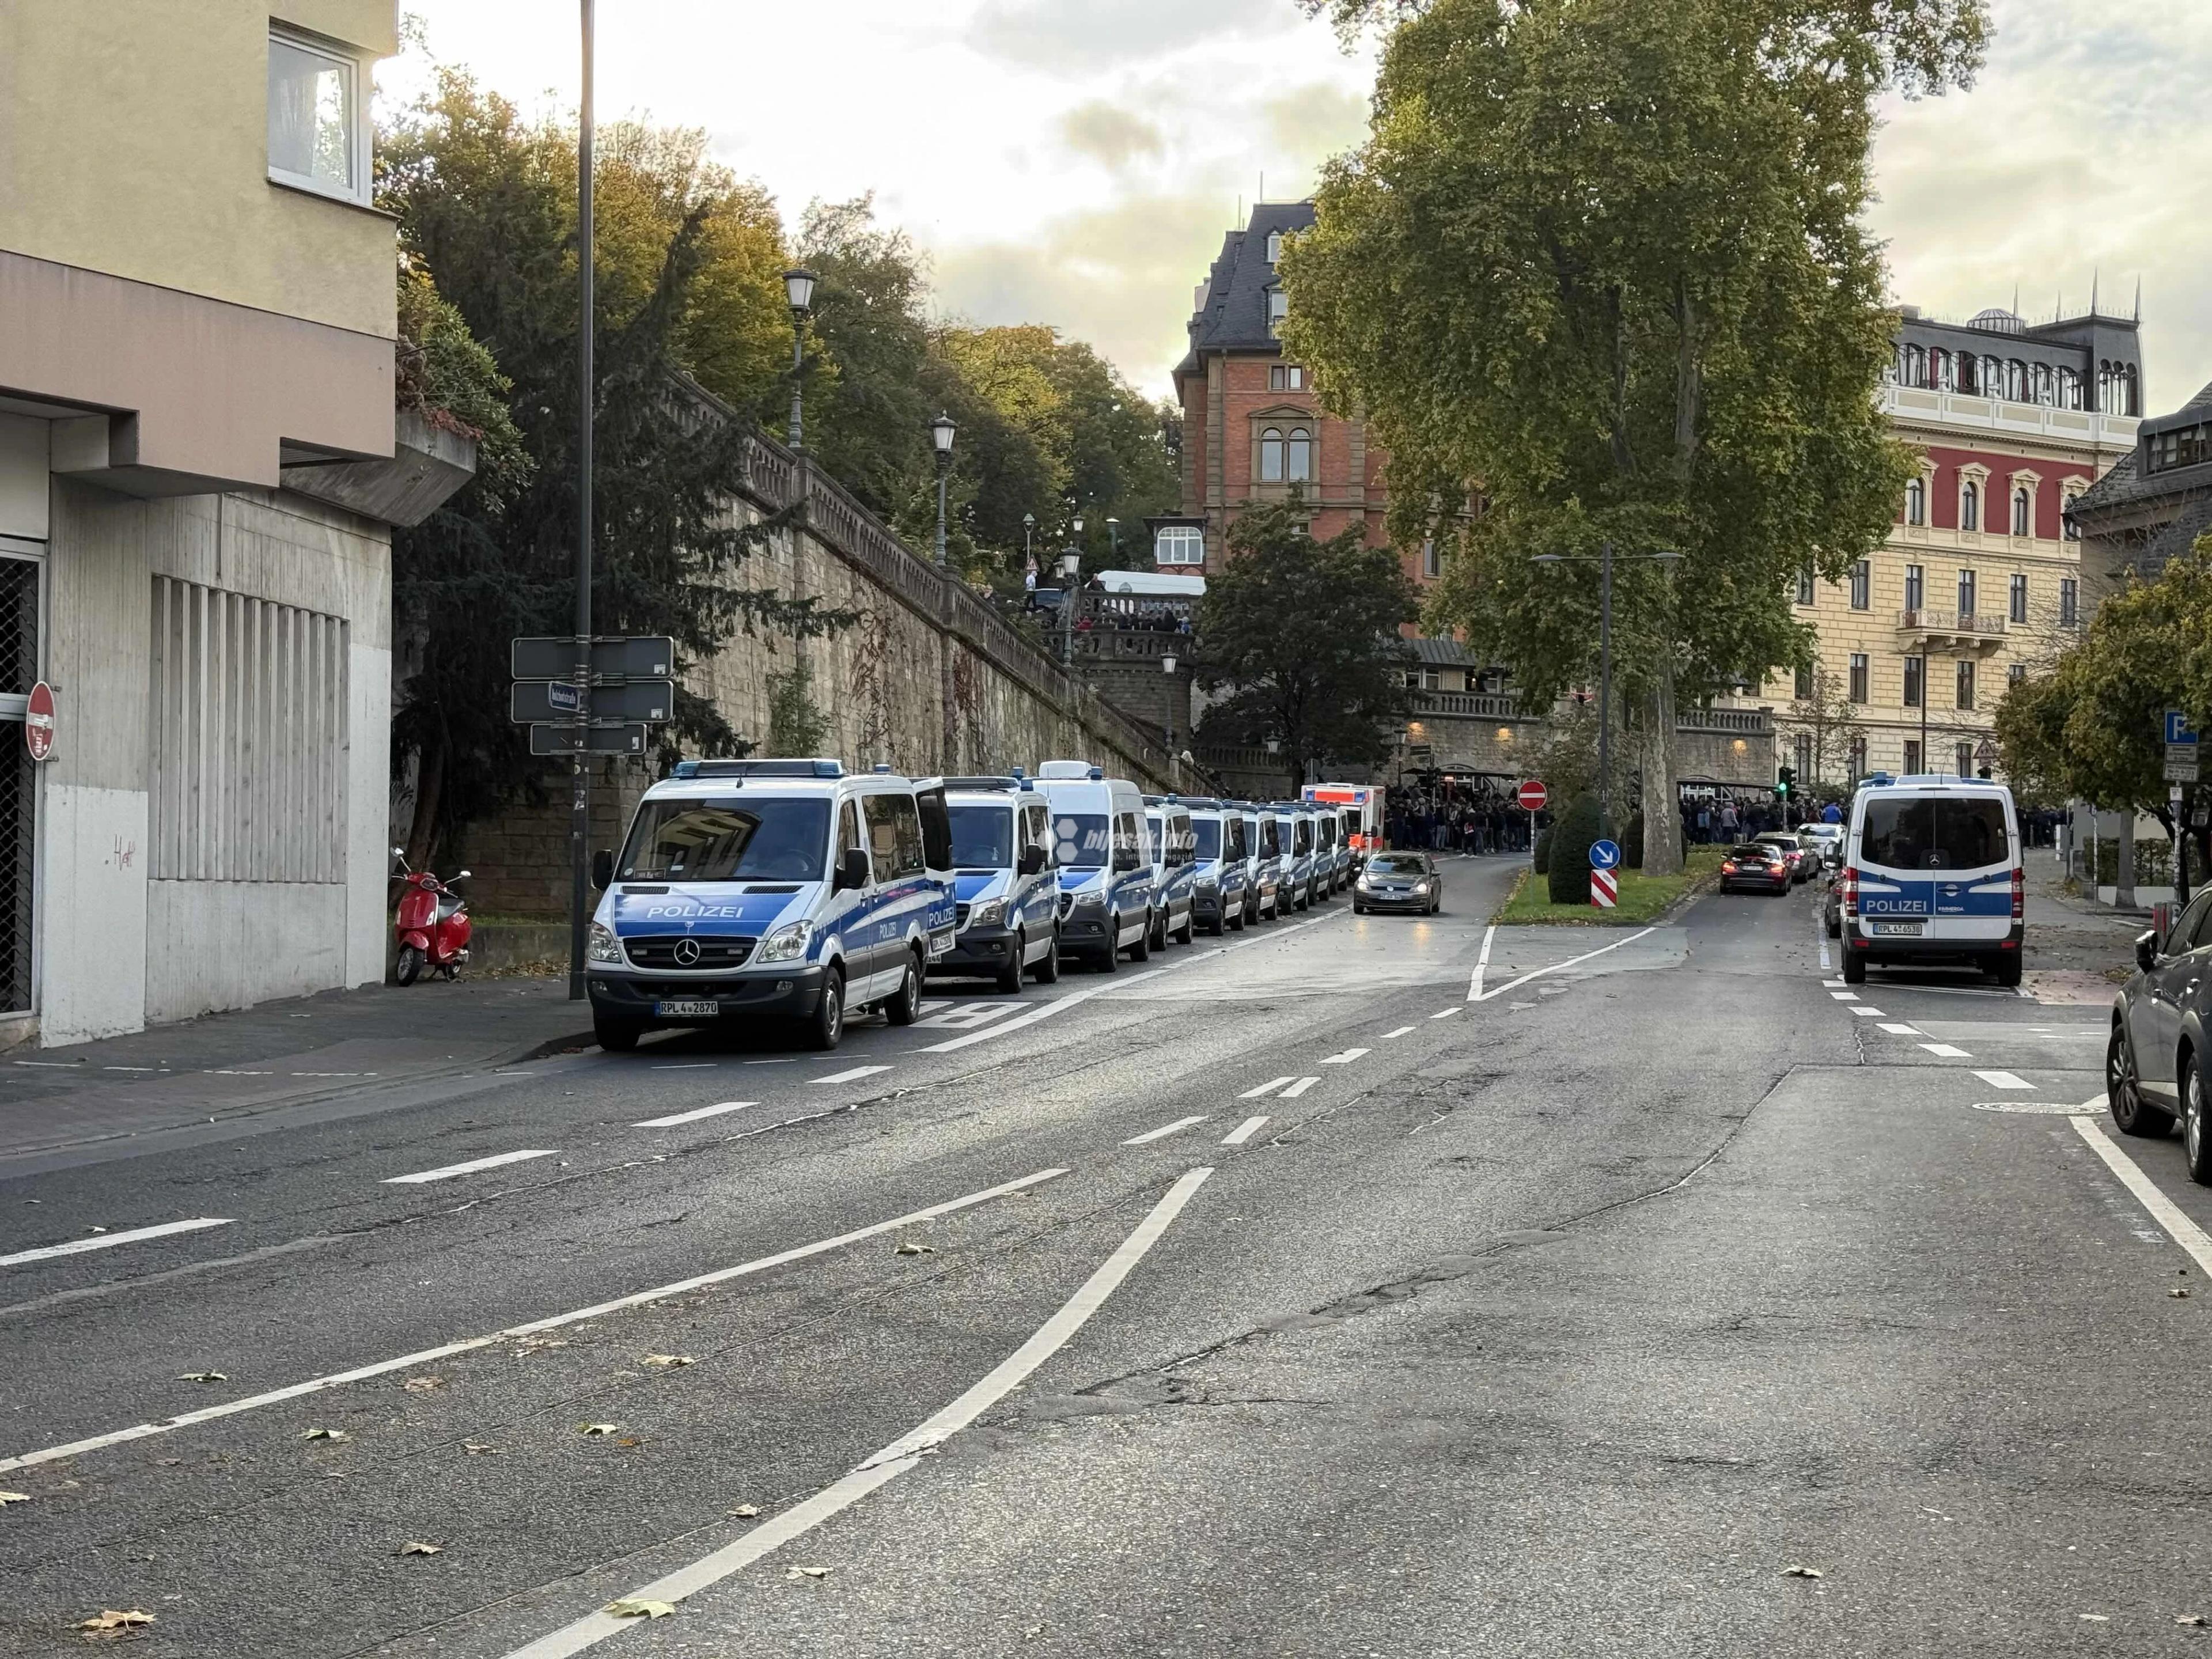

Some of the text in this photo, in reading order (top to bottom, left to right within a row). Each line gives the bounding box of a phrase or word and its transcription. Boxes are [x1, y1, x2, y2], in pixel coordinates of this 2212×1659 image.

[646, 906, 744, 919] POLIZEI
[1866, 900, 1927, 912] POLIZEI
[929, 907, 955, 927] POLIZEI
[879, 921, 896, 940] POLIZEI
[661, 1002, 717, 1013] RPL 4 2870
